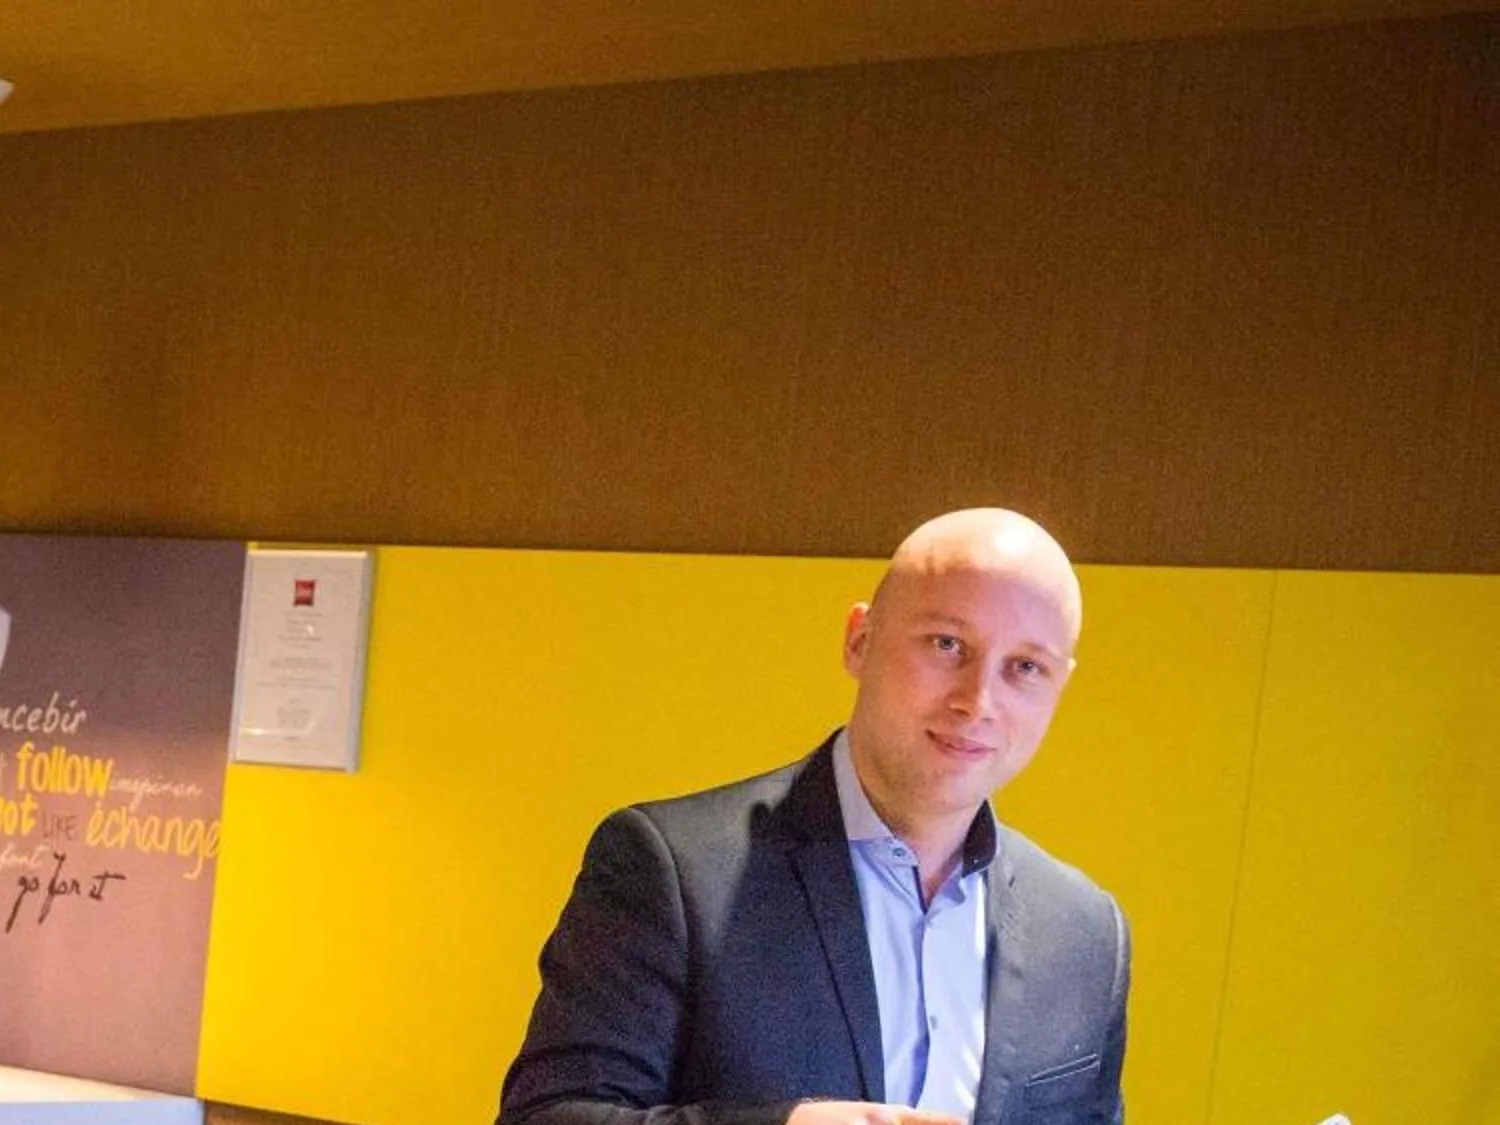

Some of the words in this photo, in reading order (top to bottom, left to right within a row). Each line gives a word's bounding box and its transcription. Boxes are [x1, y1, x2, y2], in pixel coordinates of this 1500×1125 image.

[16, 740, 116, 800] follow
[85, 799, 224, 880] échange
[5, 874, 41, 936] go
[37, 850, 82, 926] for
